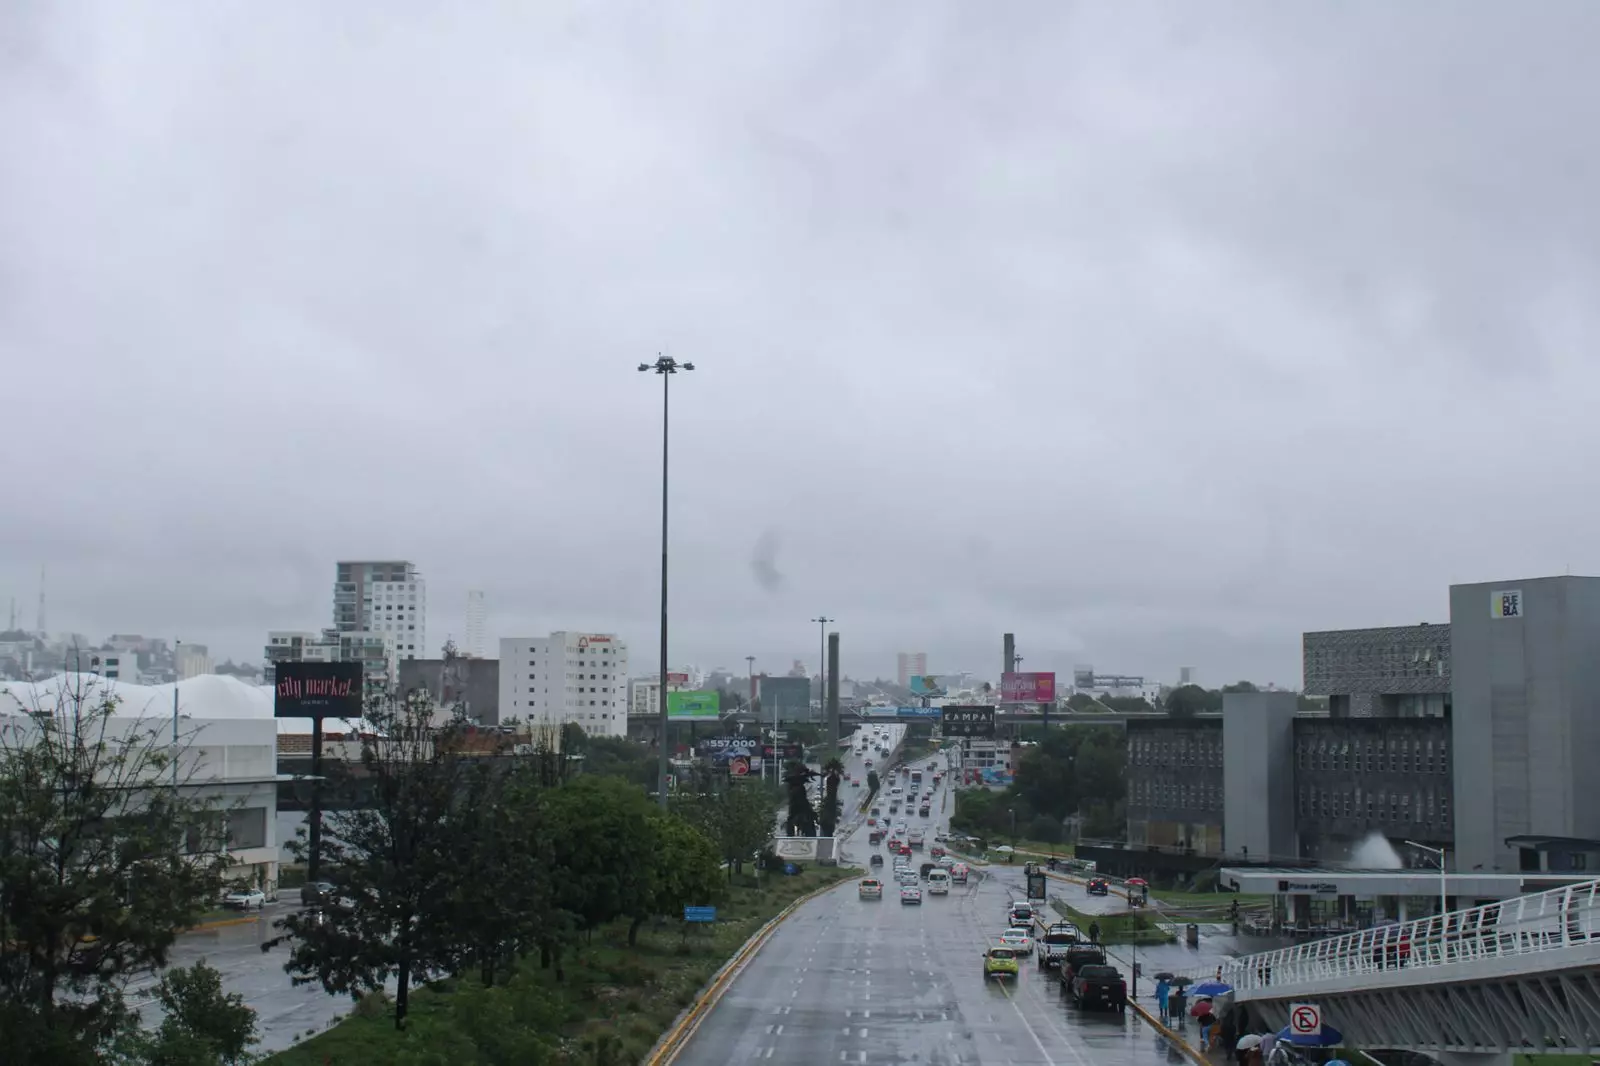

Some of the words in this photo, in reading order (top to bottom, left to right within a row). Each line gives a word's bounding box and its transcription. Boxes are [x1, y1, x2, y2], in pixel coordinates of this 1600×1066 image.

[1503, 595, 1518, 605] PUE
[1503, 606, 1518, 616] BLA
[278, 676, 302, 698] city
[305, 676, 351, 696] market
[945, 713, 992, 721] KAMPAI
